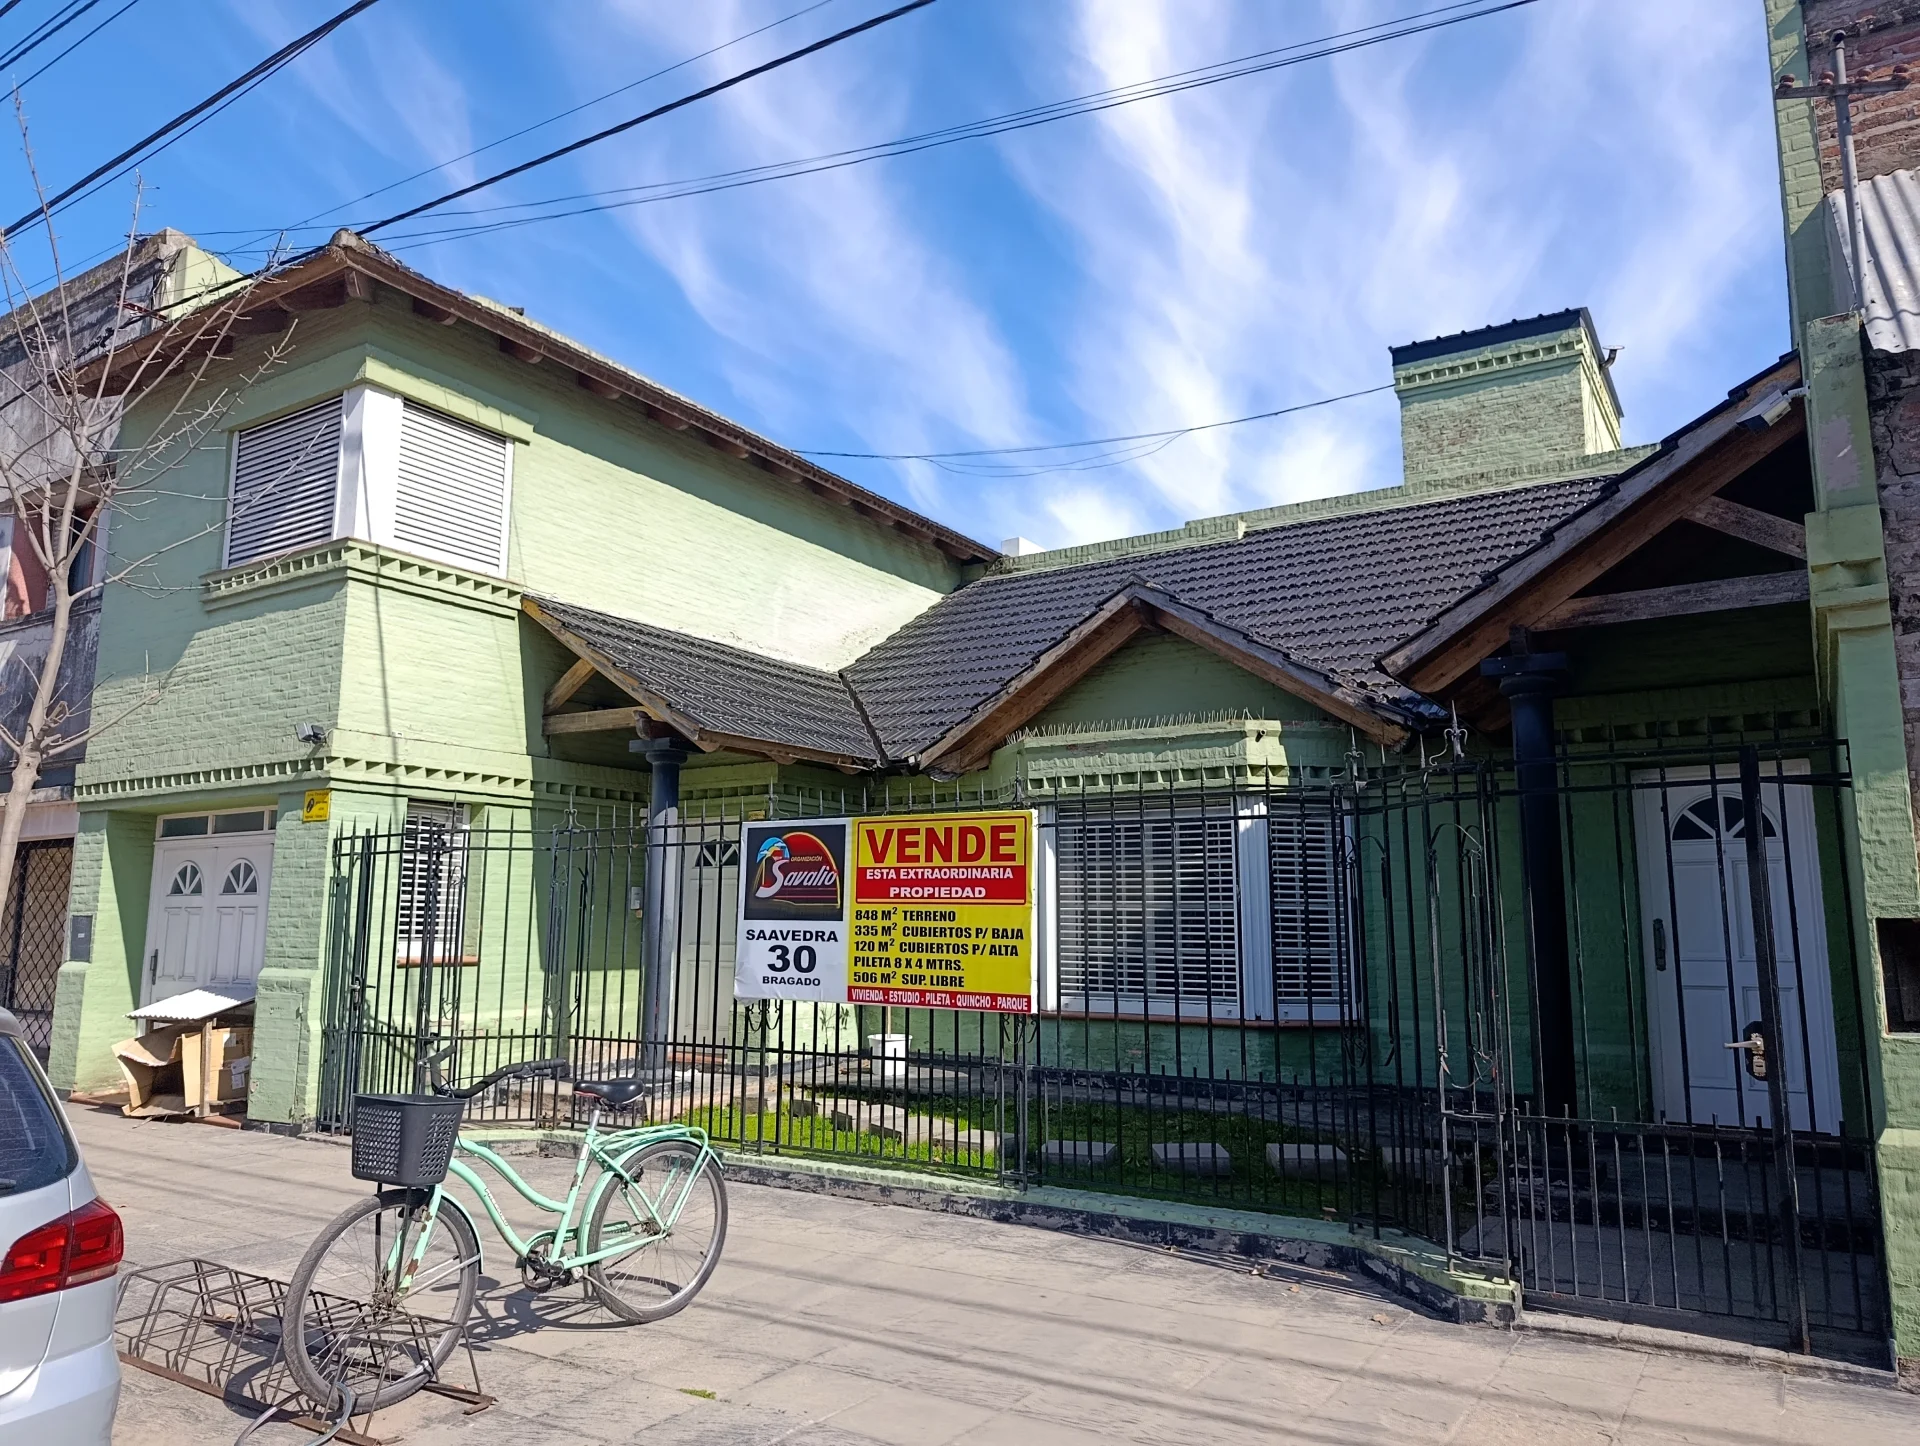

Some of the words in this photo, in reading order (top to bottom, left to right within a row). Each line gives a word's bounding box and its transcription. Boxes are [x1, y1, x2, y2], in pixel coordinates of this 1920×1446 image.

[865, 825, 1017, 864] VENDE
[755, 859, 838, 898] Savalio
[866, 868, 896, 880] ESTA
[900, 867, 1013, 880] EXTRAORDINARIA
[889, 887, 986, 898] PROPIEDAD
[855, 909, 878, 921] 848
[902, 910, 956, 922] TERRENO
[745, 929, 839, 943] SAAVEDRA
[854, 925, 878, 937] 335
[902, 926, 972, 939] CUBIERTOS
[975, 927, 988, 940] P/
[991, 928, 1024, 940] BAJA
[854, 940, 875, 952] 120
[899, 941, 969, 955] CUBIERTOS
[972, 943, 987, 956] P/
[988, 944, 1019, 957] ALTA
[767, 944, 817, 973] 30
[854, 956, 891, 968] PILETA
[894, 957, 902, 969] 8
[904, 957, 913, 969] X
[915, 958, 923, 970] 4
[926, 958, 965, 972] MTRS.
[762, 976, 821, 987] BRAGADO
[853, 971, 878, 983] 506
[901, 973, 927, 986] SUP.
[930, 975, 965, 988] LIBRE
[851, 988, 884, 1002] VIVIENDA
[889, 990, 920, 1004] ESTUDIO
[925, 992, 951, 1006] PILETA
[956, 994, 991, 1008] QUINCHO
[996, 996, 1028, 1011] PARQUE
